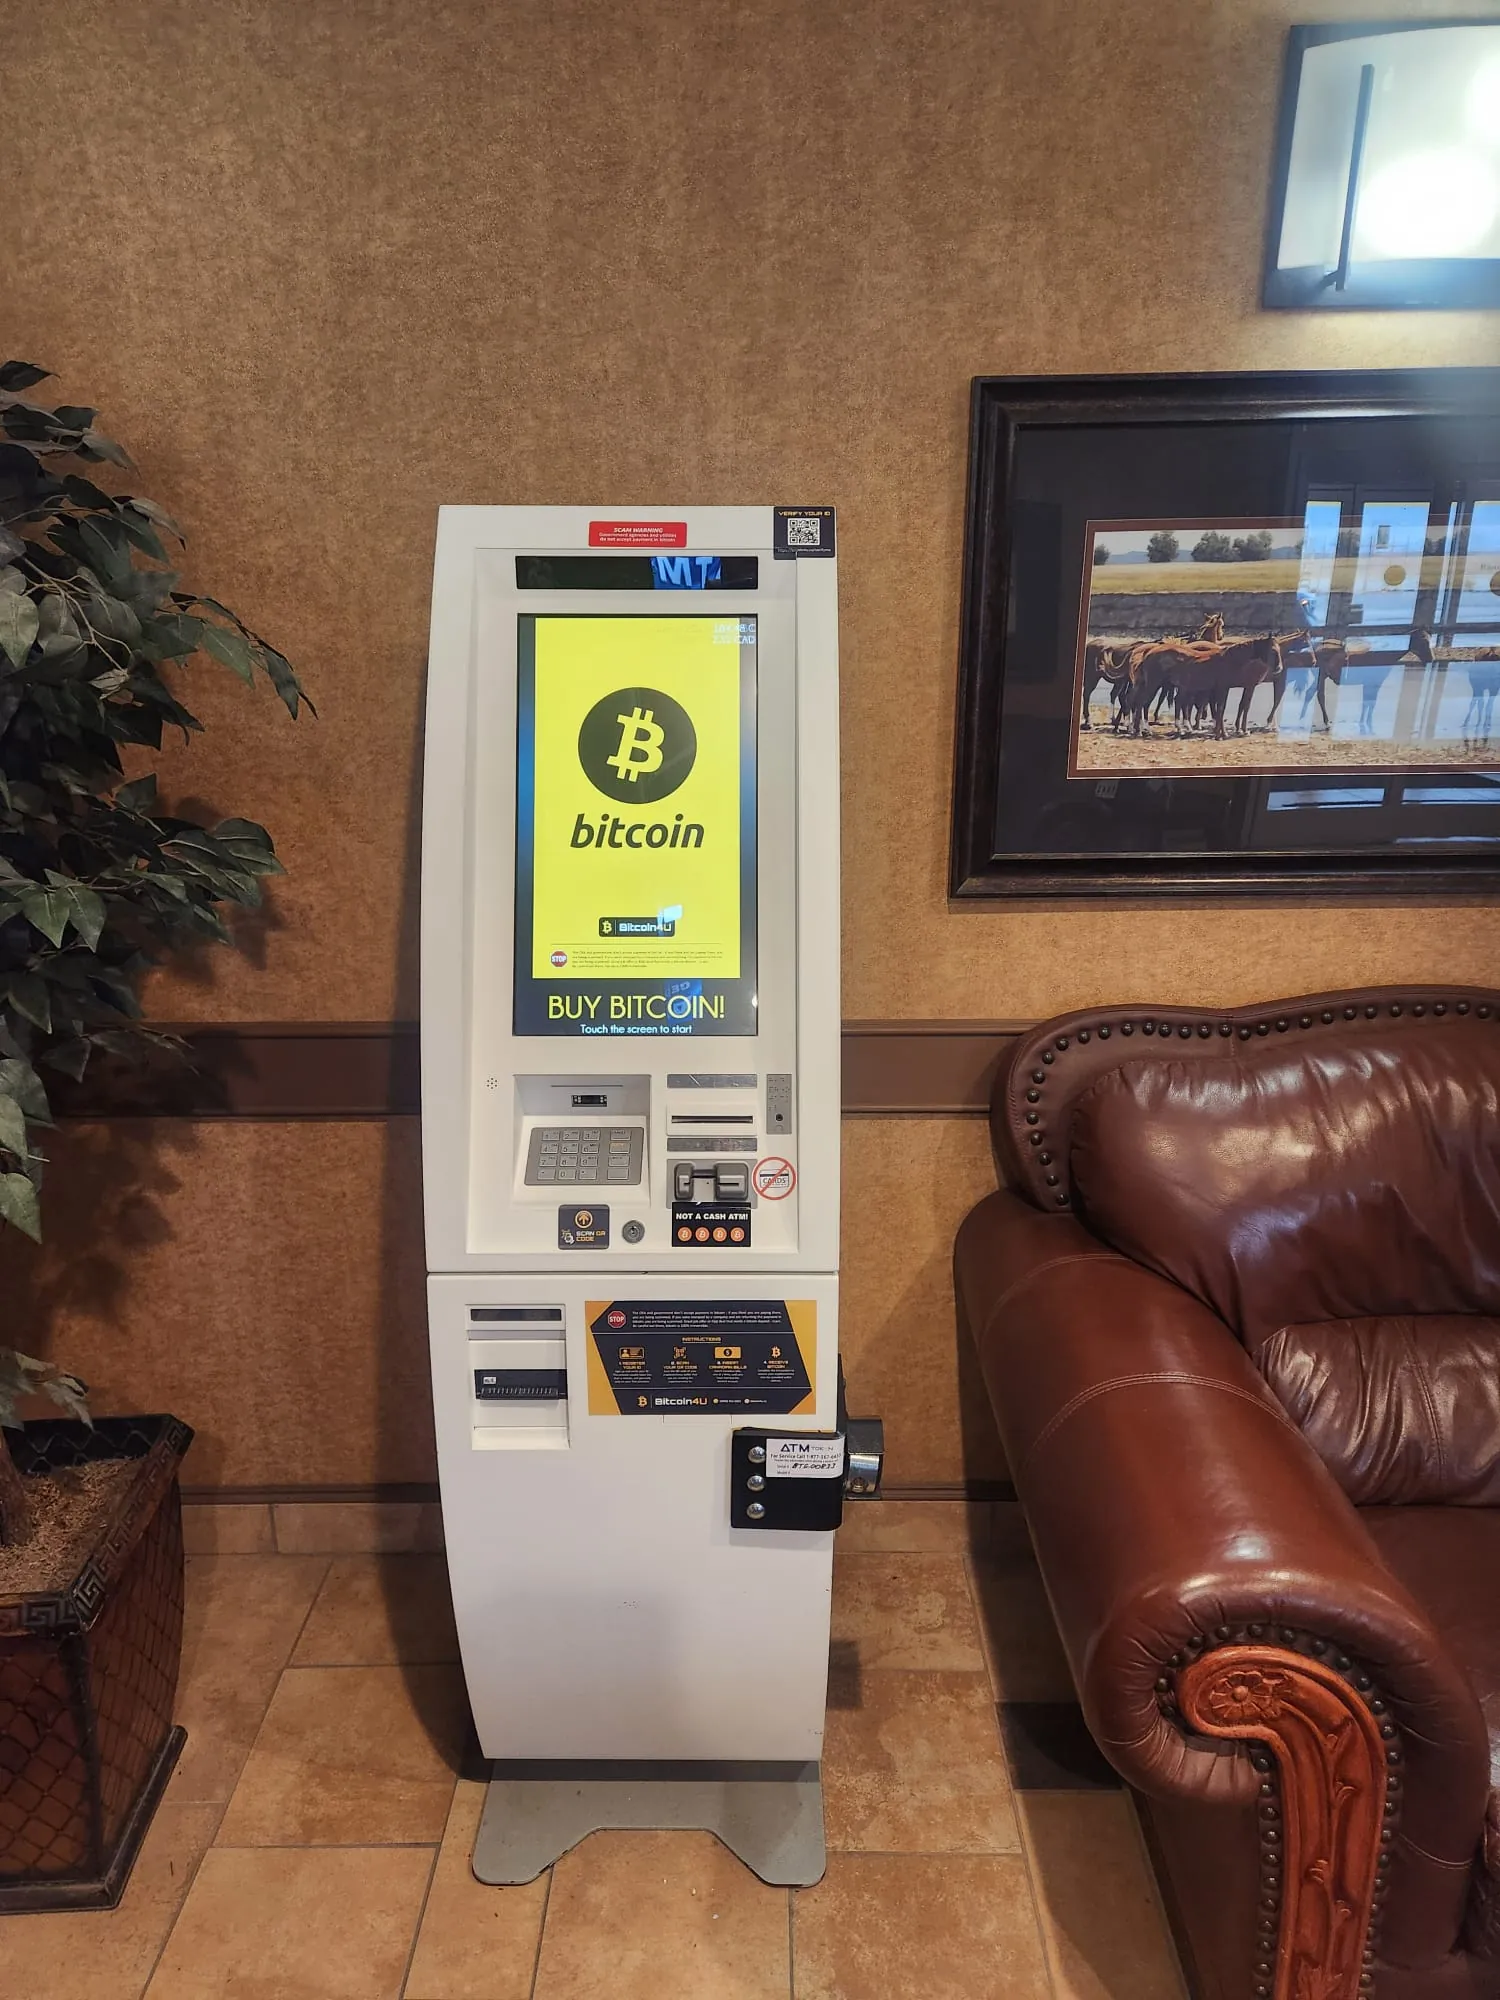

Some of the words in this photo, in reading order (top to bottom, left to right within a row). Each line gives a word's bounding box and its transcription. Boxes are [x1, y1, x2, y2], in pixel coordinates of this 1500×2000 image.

[570, 813, 705, 849] bitcoin
[619, 923, 672, 932] Bitcoin4U
[551, 955, 567, 963] STOP
[548, 995, 602, 1019] BUY
[610, 995, 725, 1019] BITCOIN!
[580, 1023, 609, 1034] Touch
[610, 1023, 625, 1034] the
[626, 1025, 657, 1034] screen
[659, 1024, 670, 1034] to
[672, 1024, 692, 1034] start
[655, 1397, 708, 1406] Bitcoin4U
[781, 1443, 810, 1453] ATM
